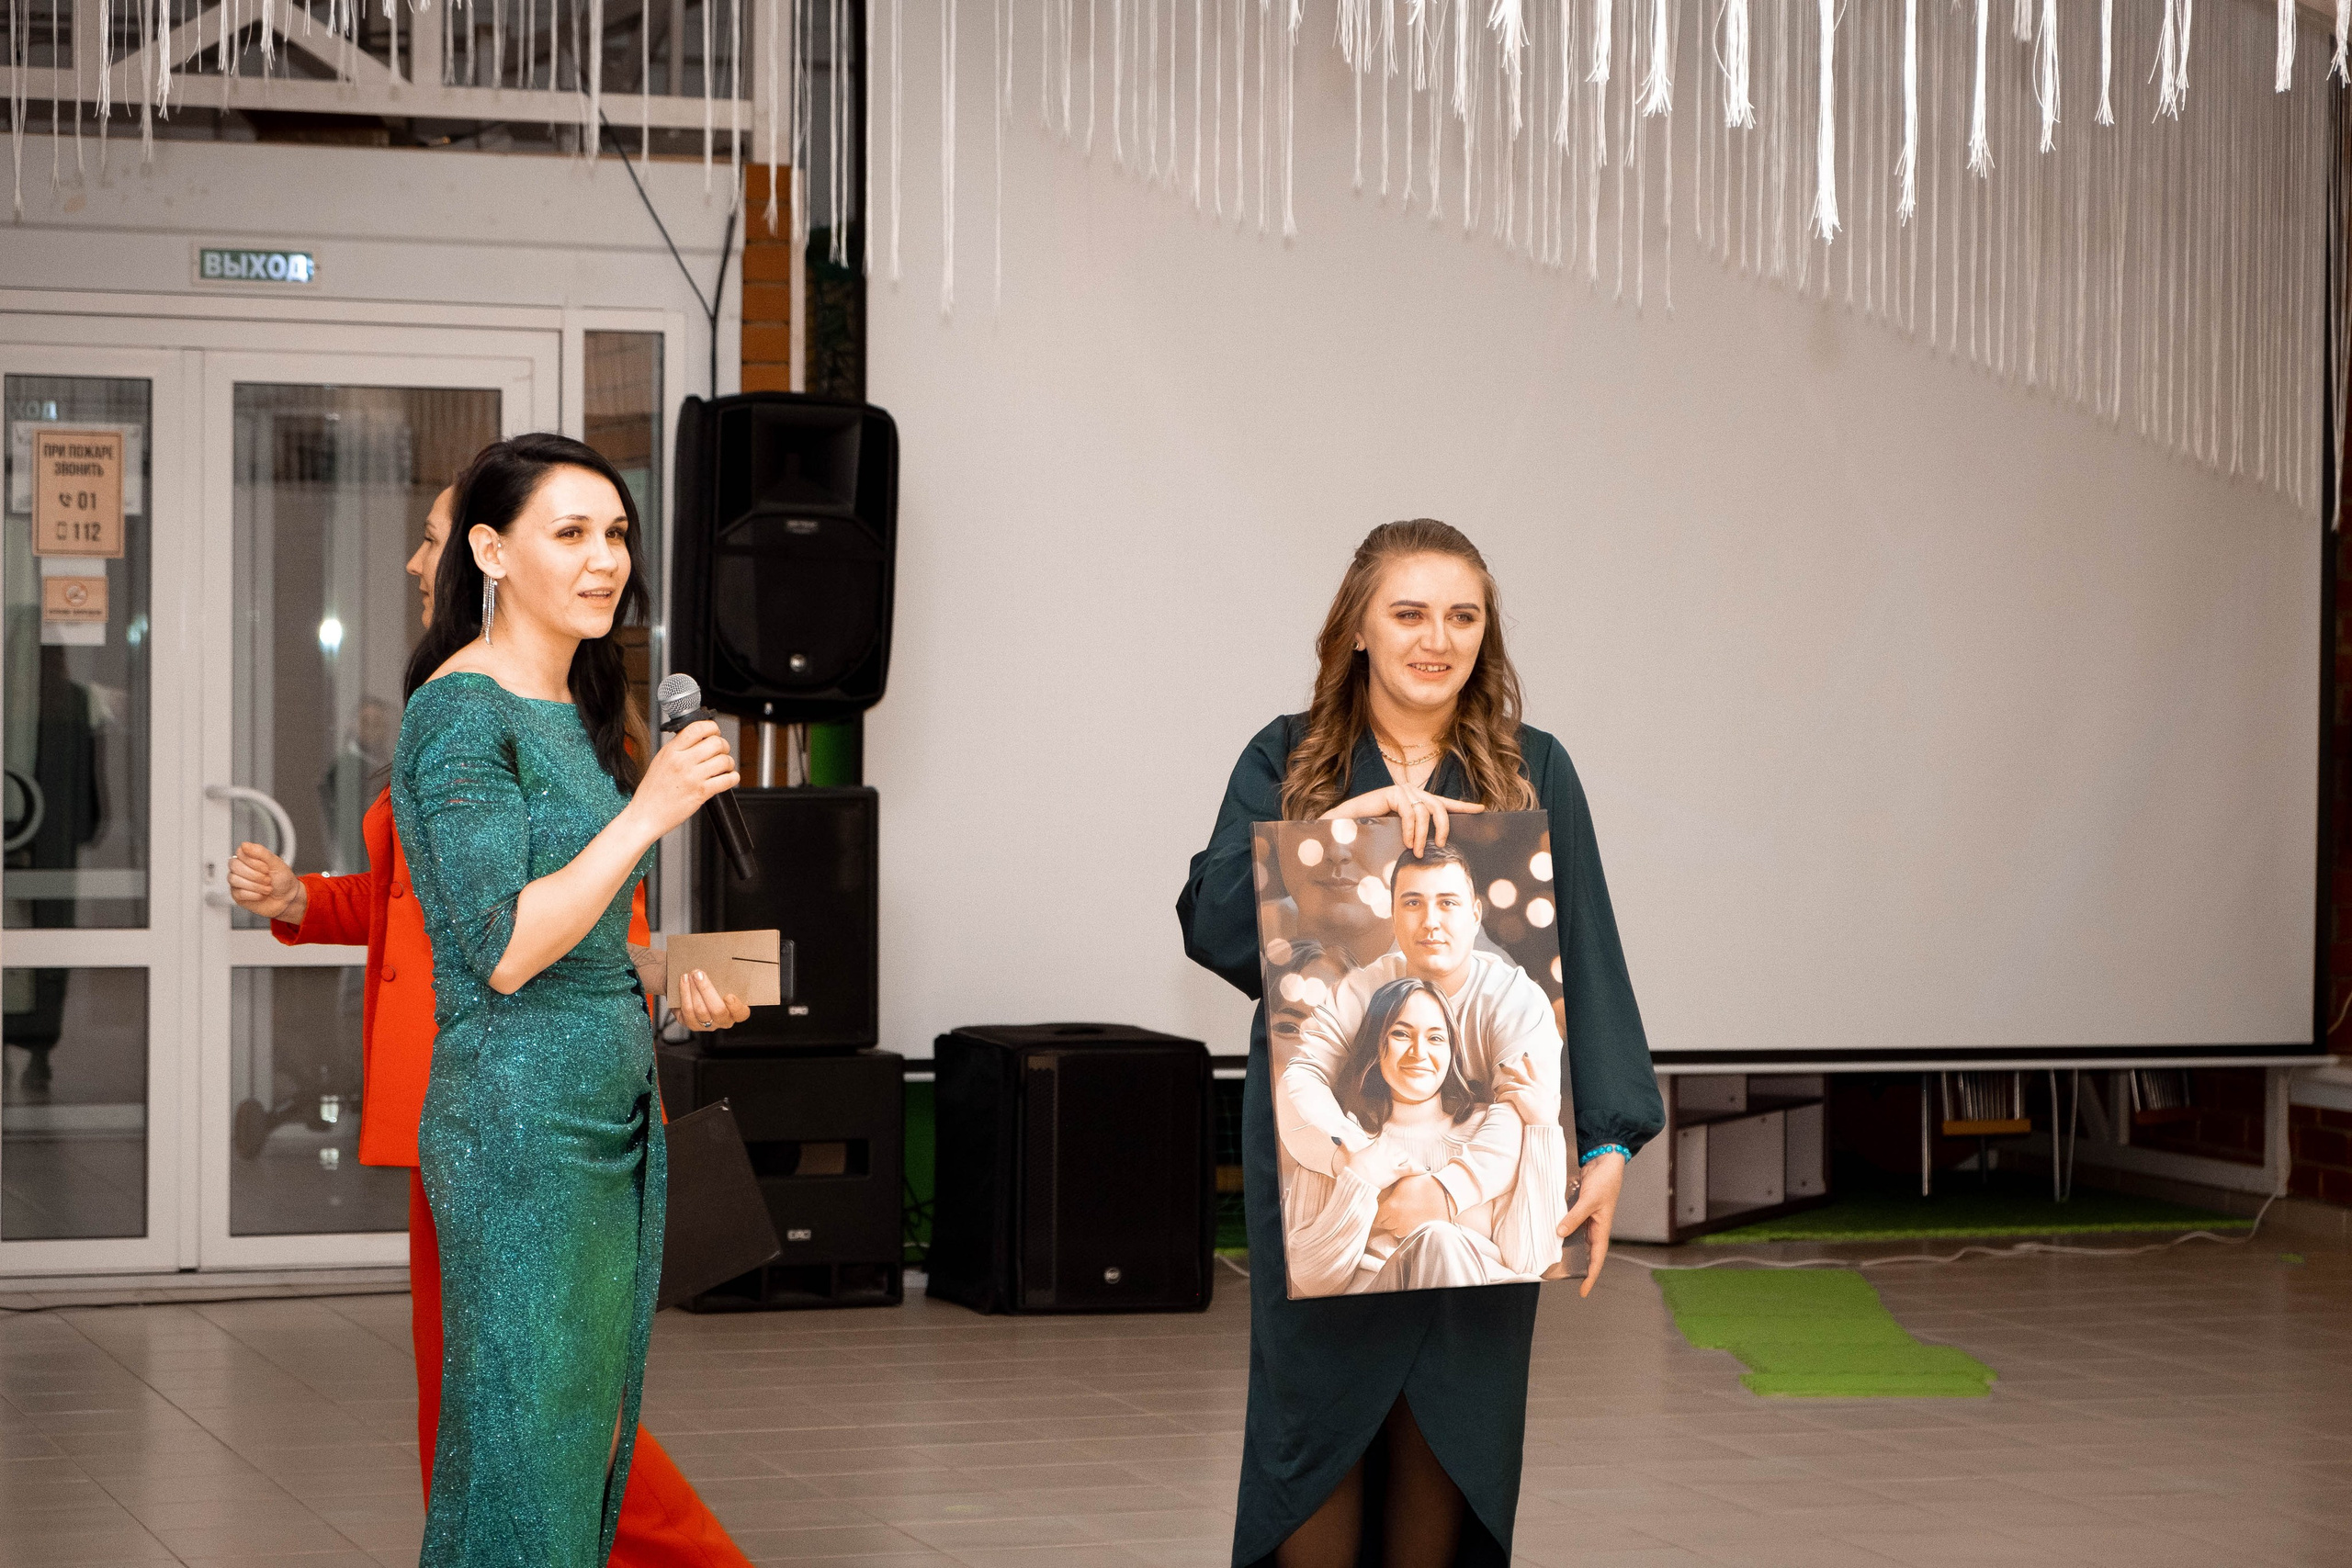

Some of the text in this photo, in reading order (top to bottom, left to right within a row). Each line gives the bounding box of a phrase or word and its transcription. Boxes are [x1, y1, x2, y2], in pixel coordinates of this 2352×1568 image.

[204, 253, 309, 282] ВЫХОД
[44, 443, 66, 457] ПРИ
[54, 461, 104, 477] ЗВОНИТЬ
[77, 491, 96, 510] 01
[74, 522, 101, 542] 112
